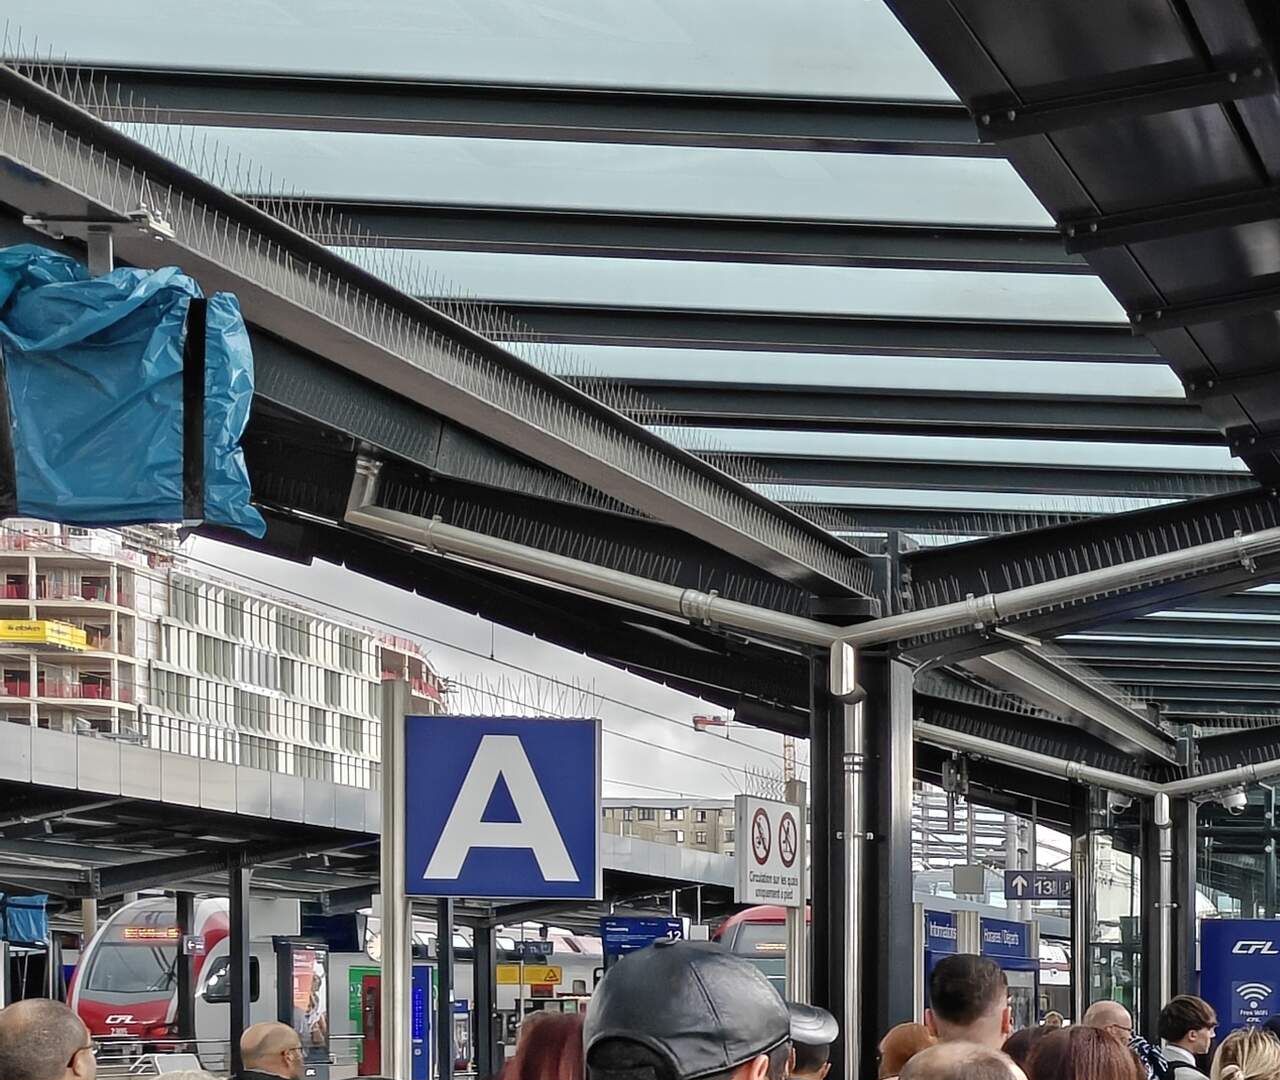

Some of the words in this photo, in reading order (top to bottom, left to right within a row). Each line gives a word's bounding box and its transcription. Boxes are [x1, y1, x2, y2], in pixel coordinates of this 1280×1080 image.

[423, 735, 580, 881] A
[1034, 880, 1053, 895] 13
[1231, 940, 1280, 955] CFL
[105, 1015, 138, 1024] CFL
